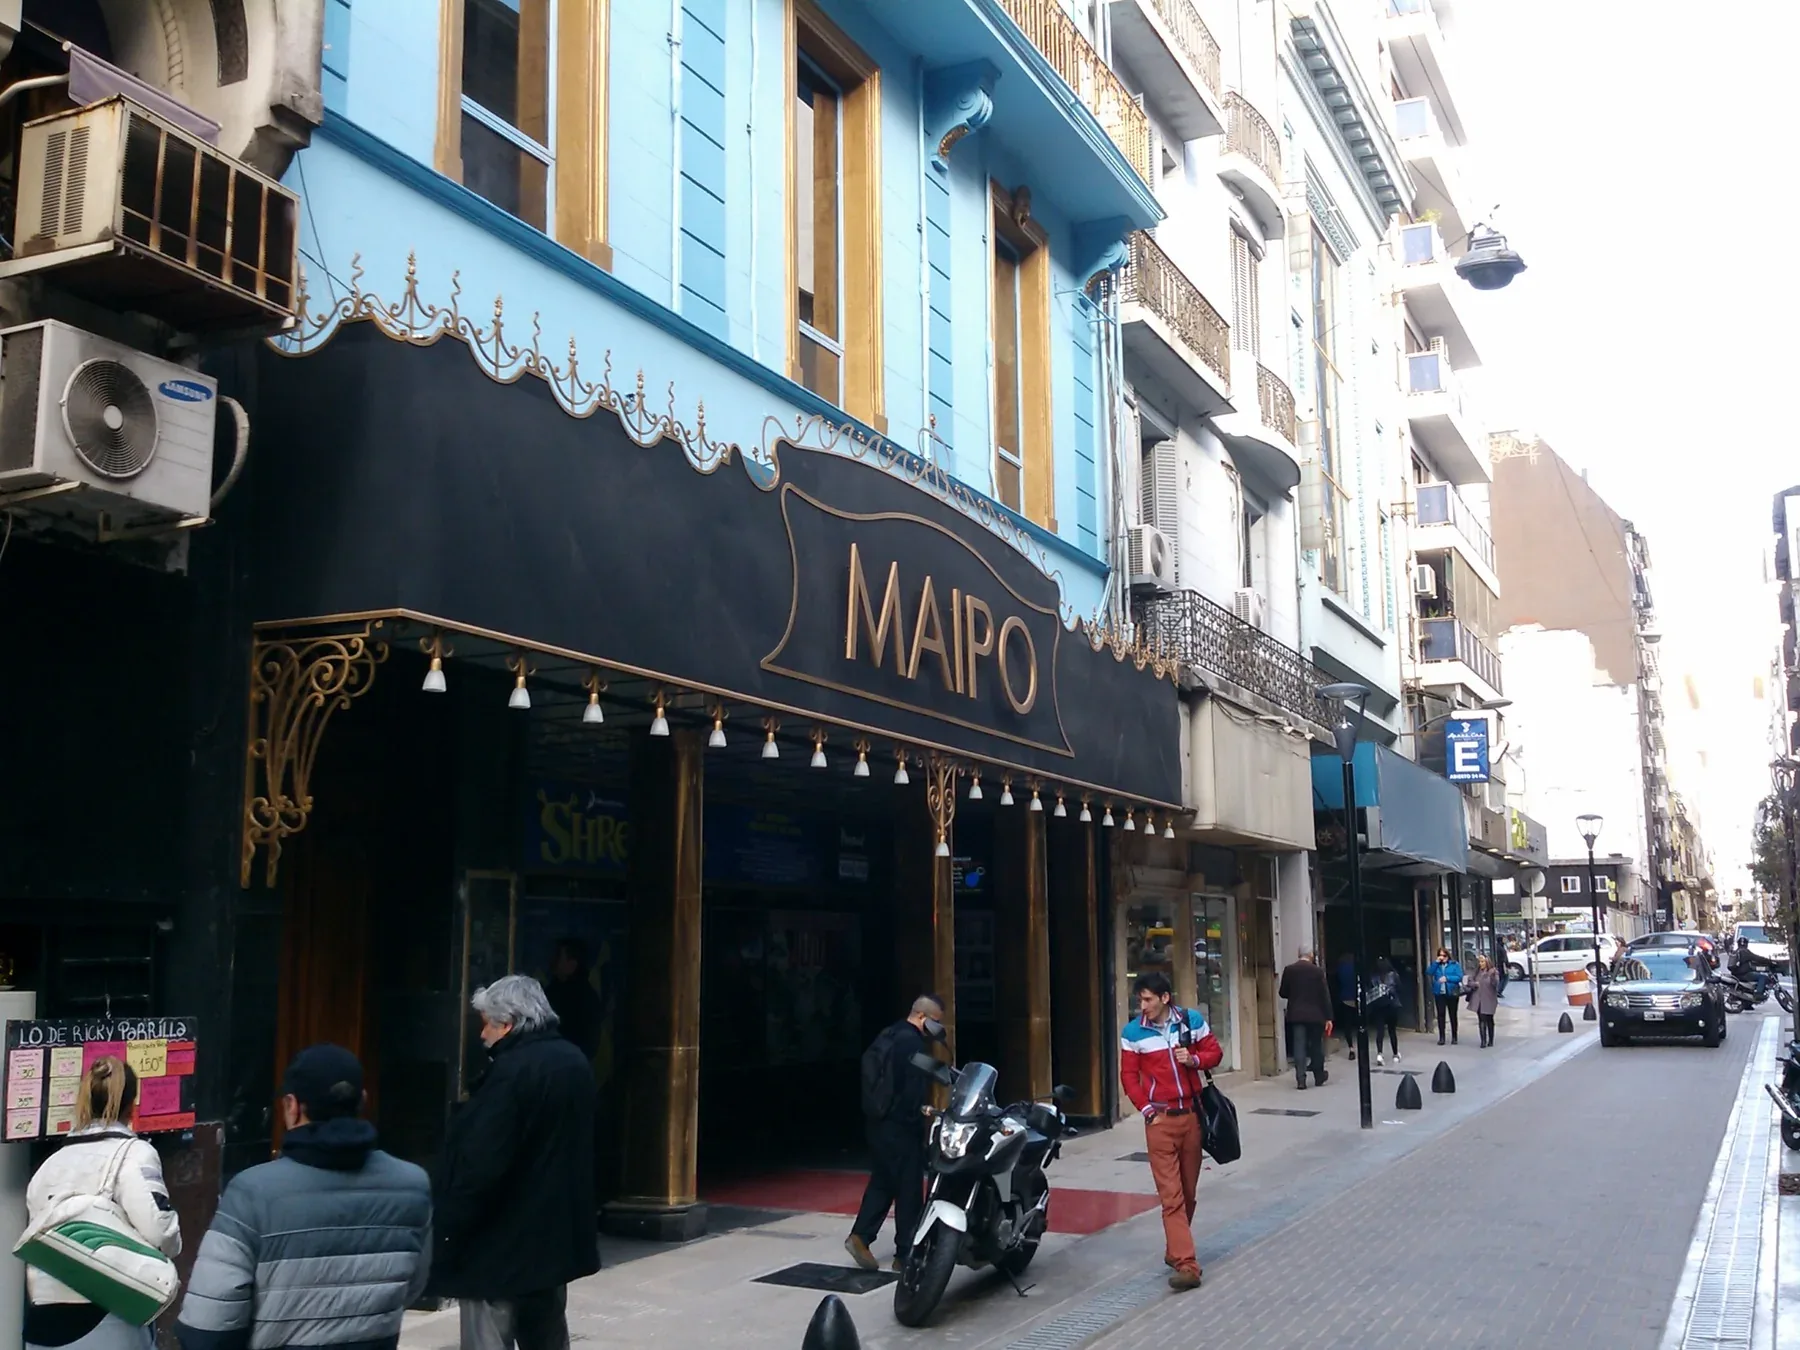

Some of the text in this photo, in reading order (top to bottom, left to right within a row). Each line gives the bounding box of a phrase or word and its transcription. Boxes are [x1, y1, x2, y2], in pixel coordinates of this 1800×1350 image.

[164, 381, 208, 401] SAMSUNG
[845, 543, 1037, 714] MAIPO
[1454, 741, 1480, 772] E
[536, 789, 630, 866] SHRE
[19, 1027, 43, 1044] LO
[46, 1026, 67, 1043] DE
